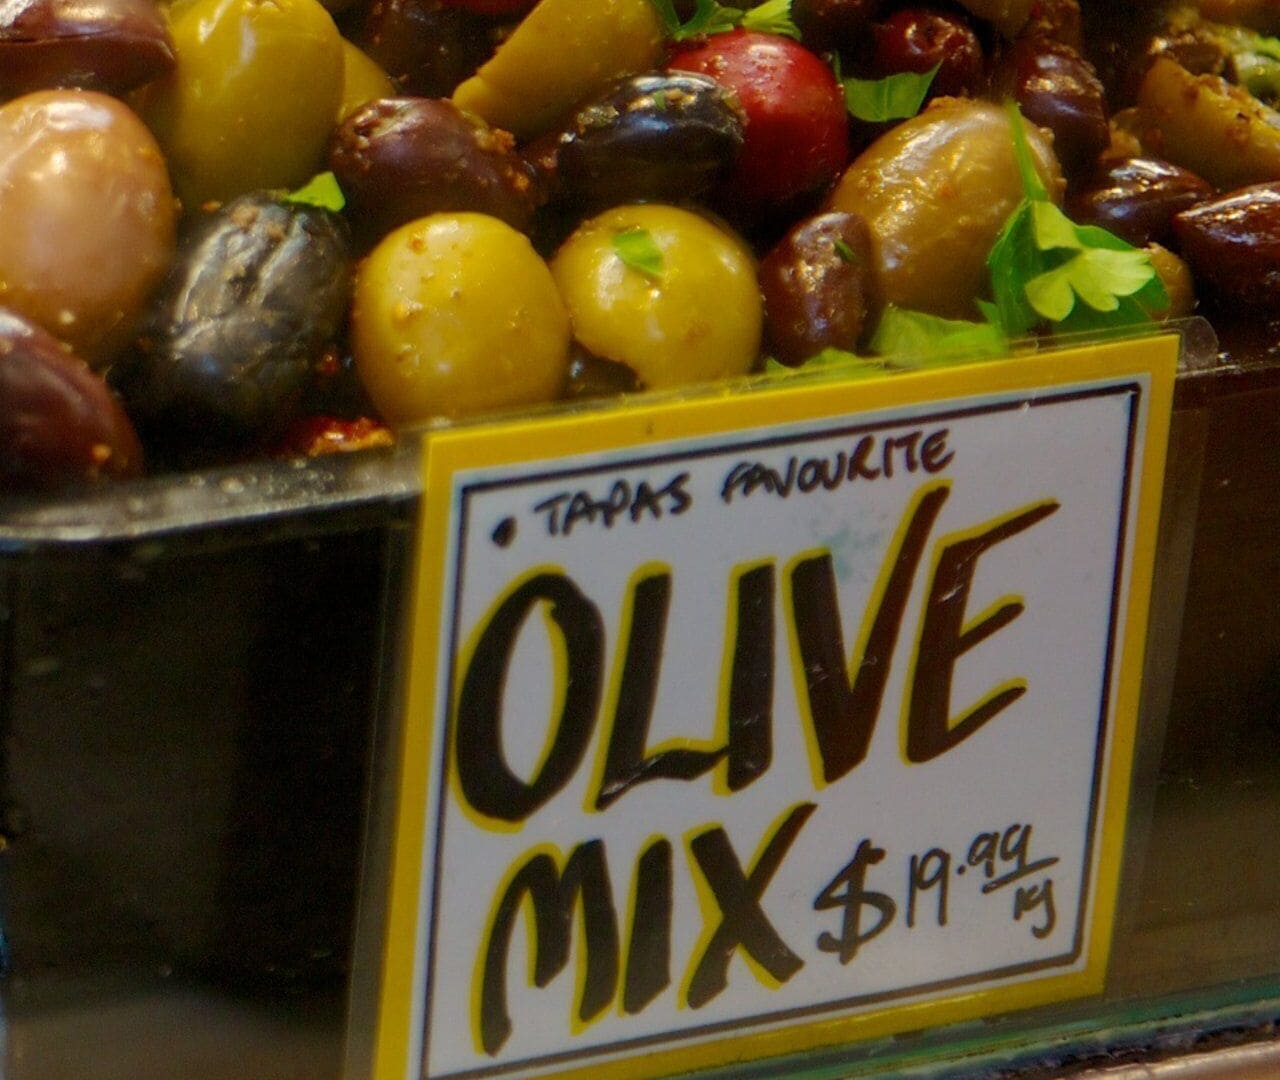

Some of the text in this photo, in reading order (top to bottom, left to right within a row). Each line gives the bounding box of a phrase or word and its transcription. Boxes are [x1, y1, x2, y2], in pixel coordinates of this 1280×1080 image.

[535, 428, 956, 536] TAPAS FAVOURITE
[448, 480, 1061, 832] OLIVE
[471, 801, 819, 1057] MIX
